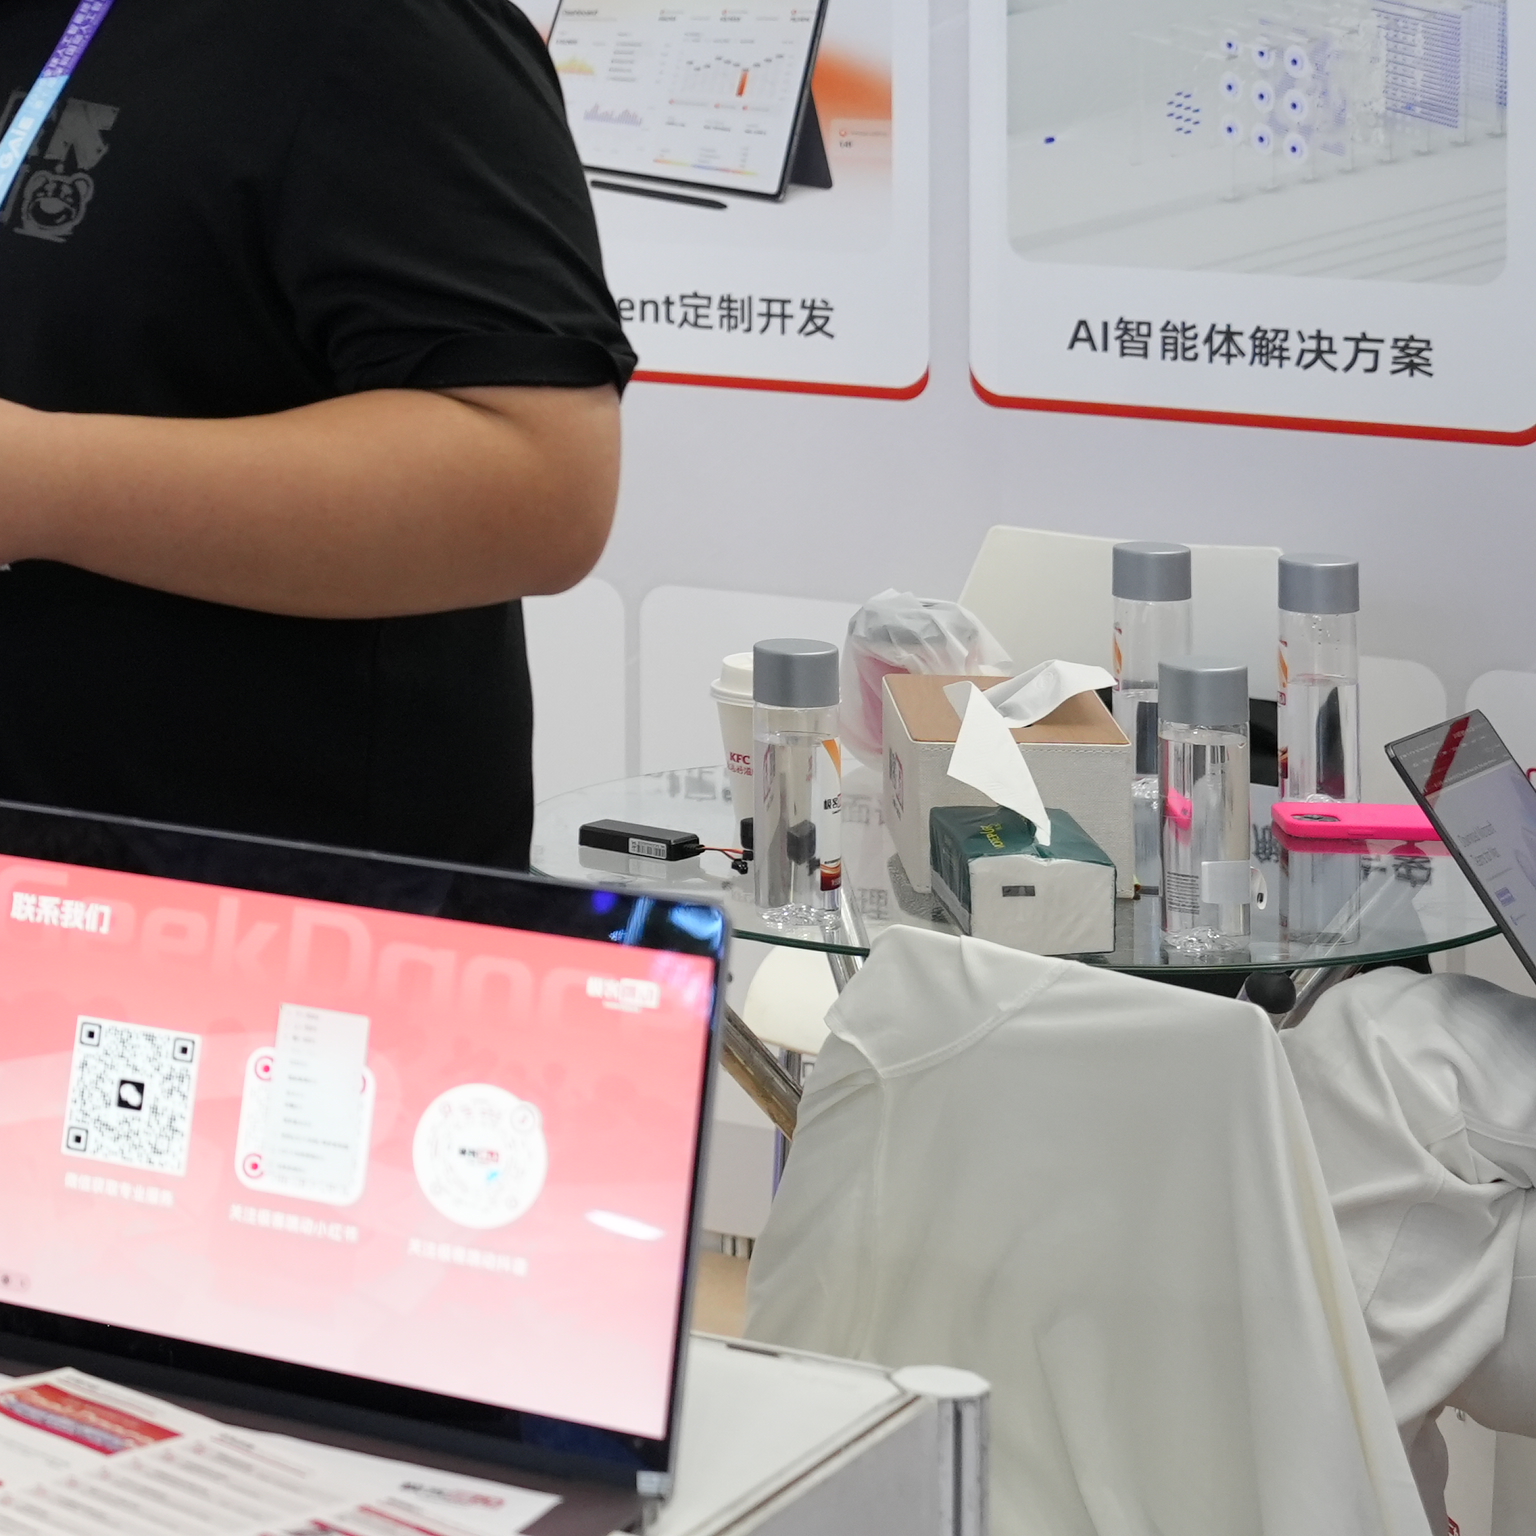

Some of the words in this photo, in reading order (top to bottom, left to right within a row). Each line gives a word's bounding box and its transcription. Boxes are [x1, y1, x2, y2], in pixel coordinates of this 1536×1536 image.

[1067, 316, 1435, 379] AI智能体解决方案
[729, 751, 751, 765] KFC
[10, 890, 113, 936] 联系我们
